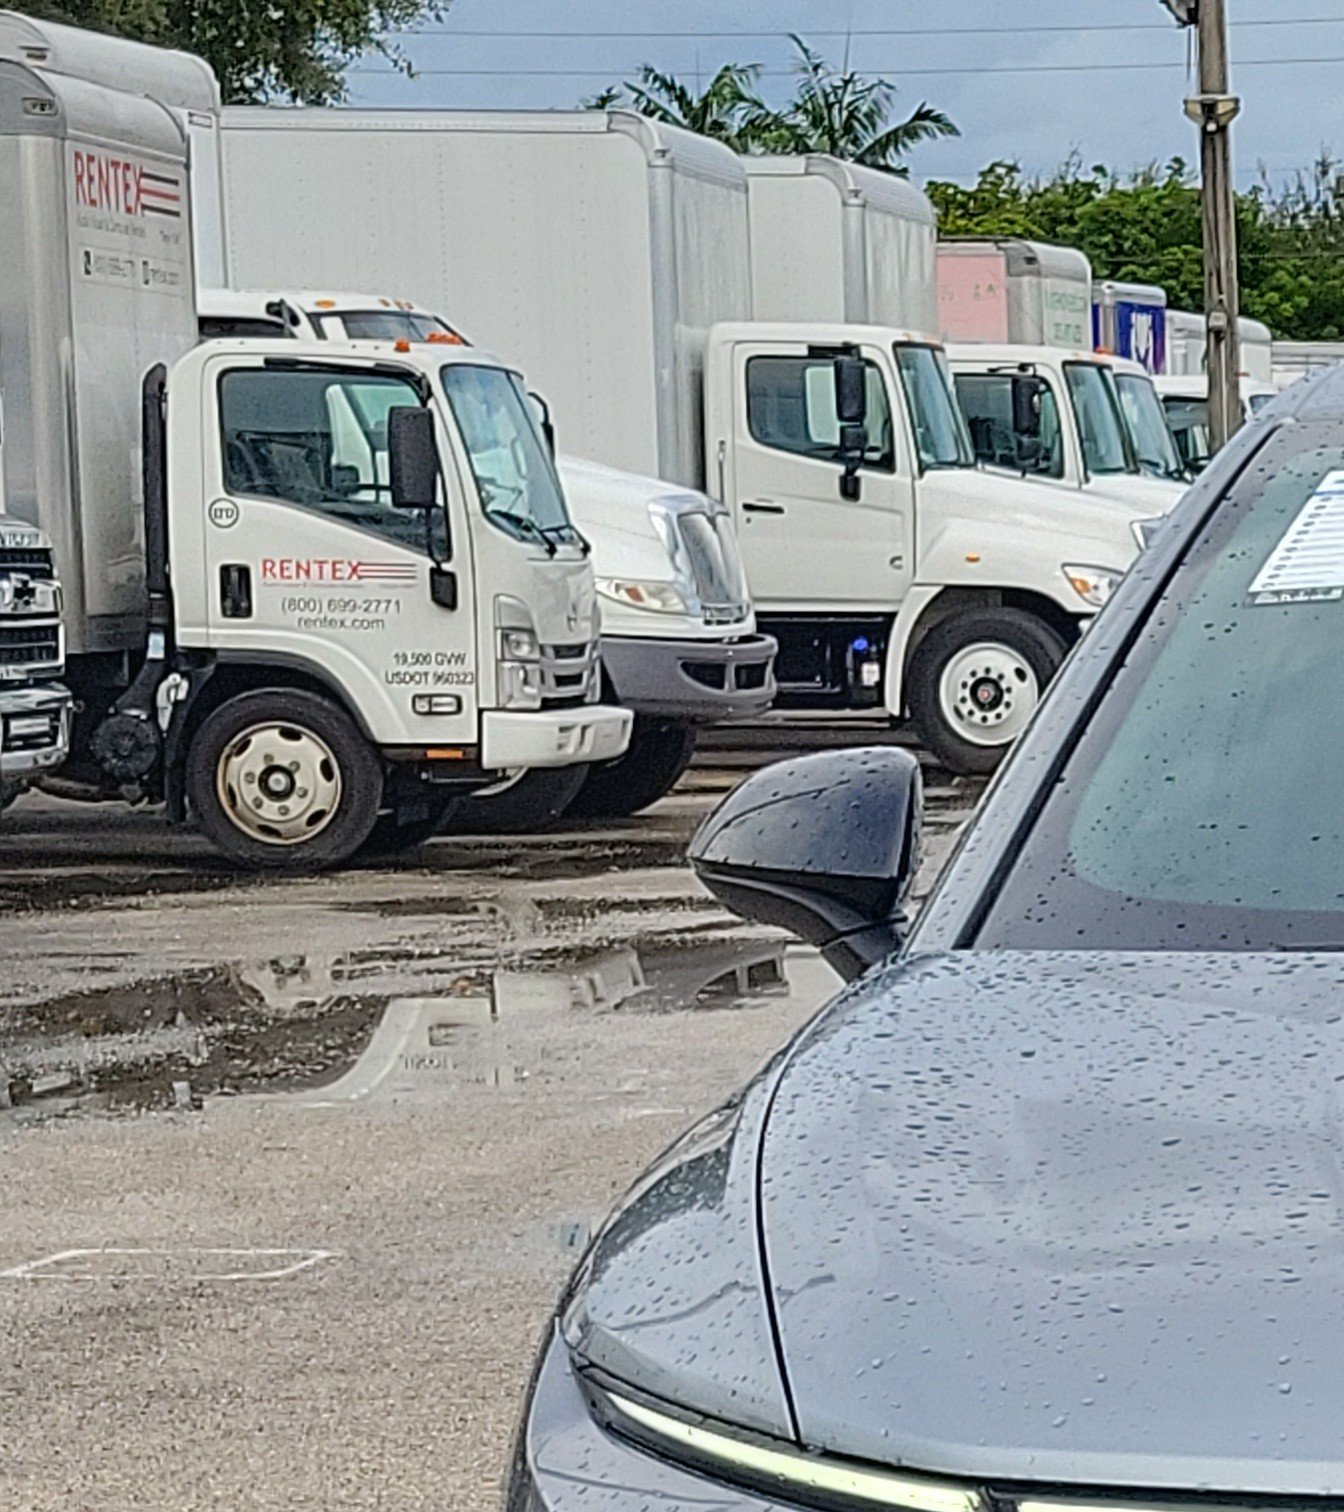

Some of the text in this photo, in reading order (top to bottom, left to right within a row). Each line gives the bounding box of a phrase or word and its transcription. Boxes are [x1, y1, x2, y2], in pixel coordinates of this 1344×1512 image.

[74, 150, 145, 217] RENTEX
[261, 558, 364, 581] RENTEX
[281, 597, 323, 614] (800)
[297, 616, 385, 630] rentex.com
[435, 652, 466, 666] GVW
[384, 670, 430, 684] USDOT
